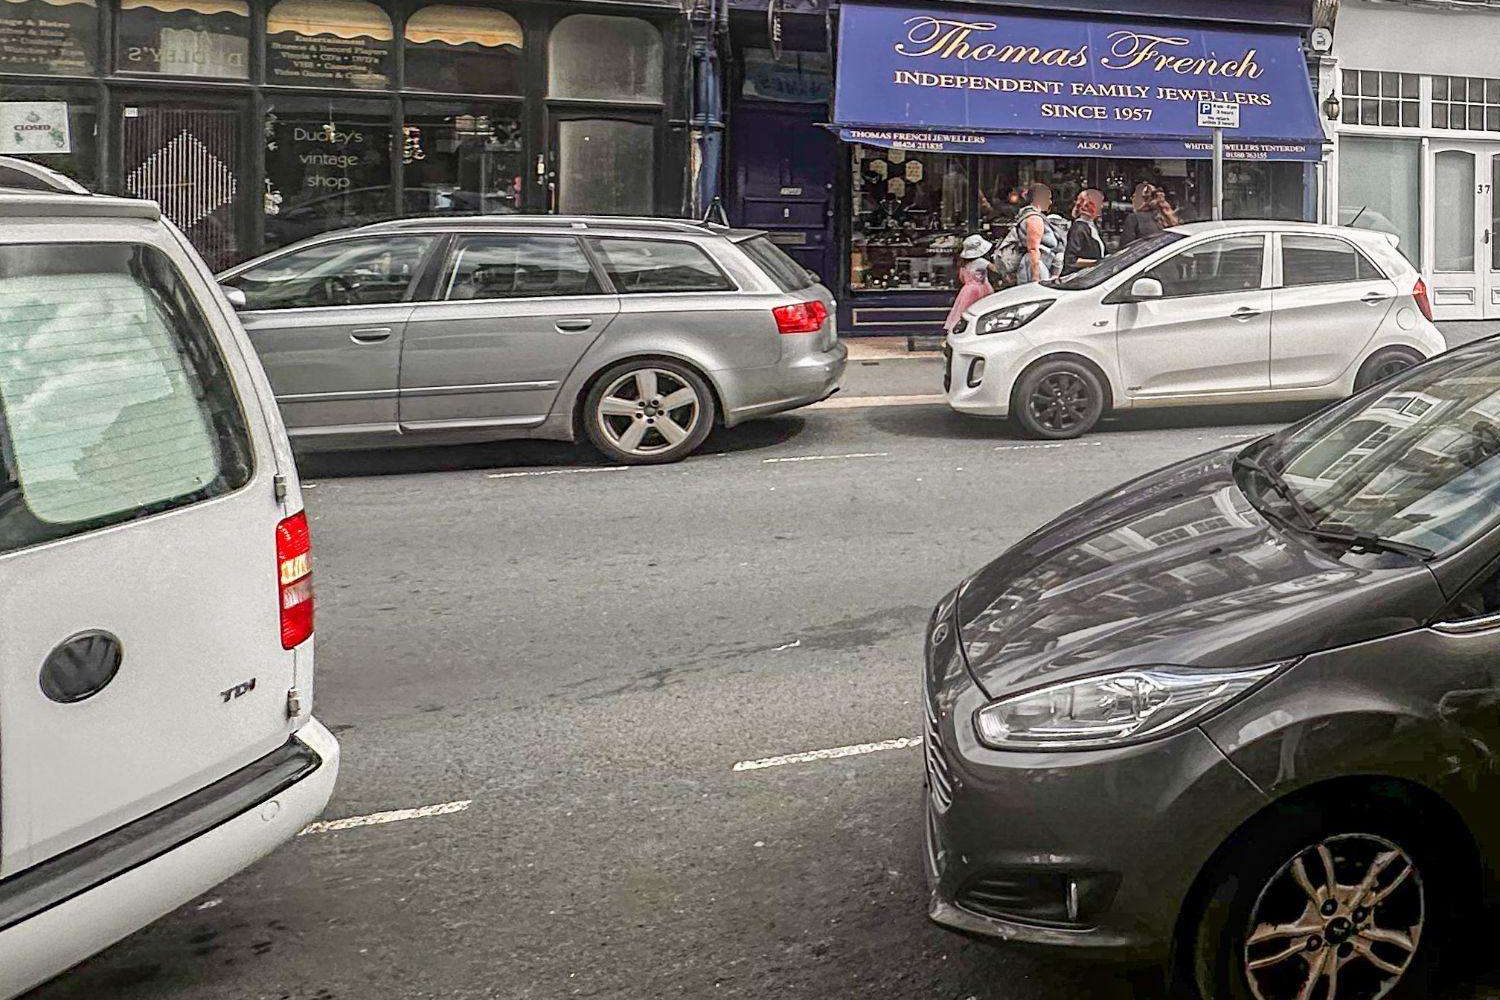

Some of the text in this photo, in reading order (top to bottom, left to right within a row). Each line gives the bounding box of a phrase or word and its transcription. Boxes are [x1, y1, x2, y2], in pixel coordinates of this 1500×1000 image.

[894, 16, 1264, 79] Thomas French
[893, 70, 1272, 106] INDEPENDENT FAMILY JEWELLERS
[1041, 103, 1153, 121] SINCE 1957
[850, 130, 986, 144] THOMAS FRENCH JEWELLERS
[1077, 142, 1114, 151] ALSO AT
[1223, 143, 1260, 152] WELLERS
[1260, 144, 1306, 153] TENTERDEN
[299, 153, 360, 168] vintage
[307, 174, 351, 189] shop
[1476, 184, 1491, 194] 37
[220, 677, 256, 703] TDI
